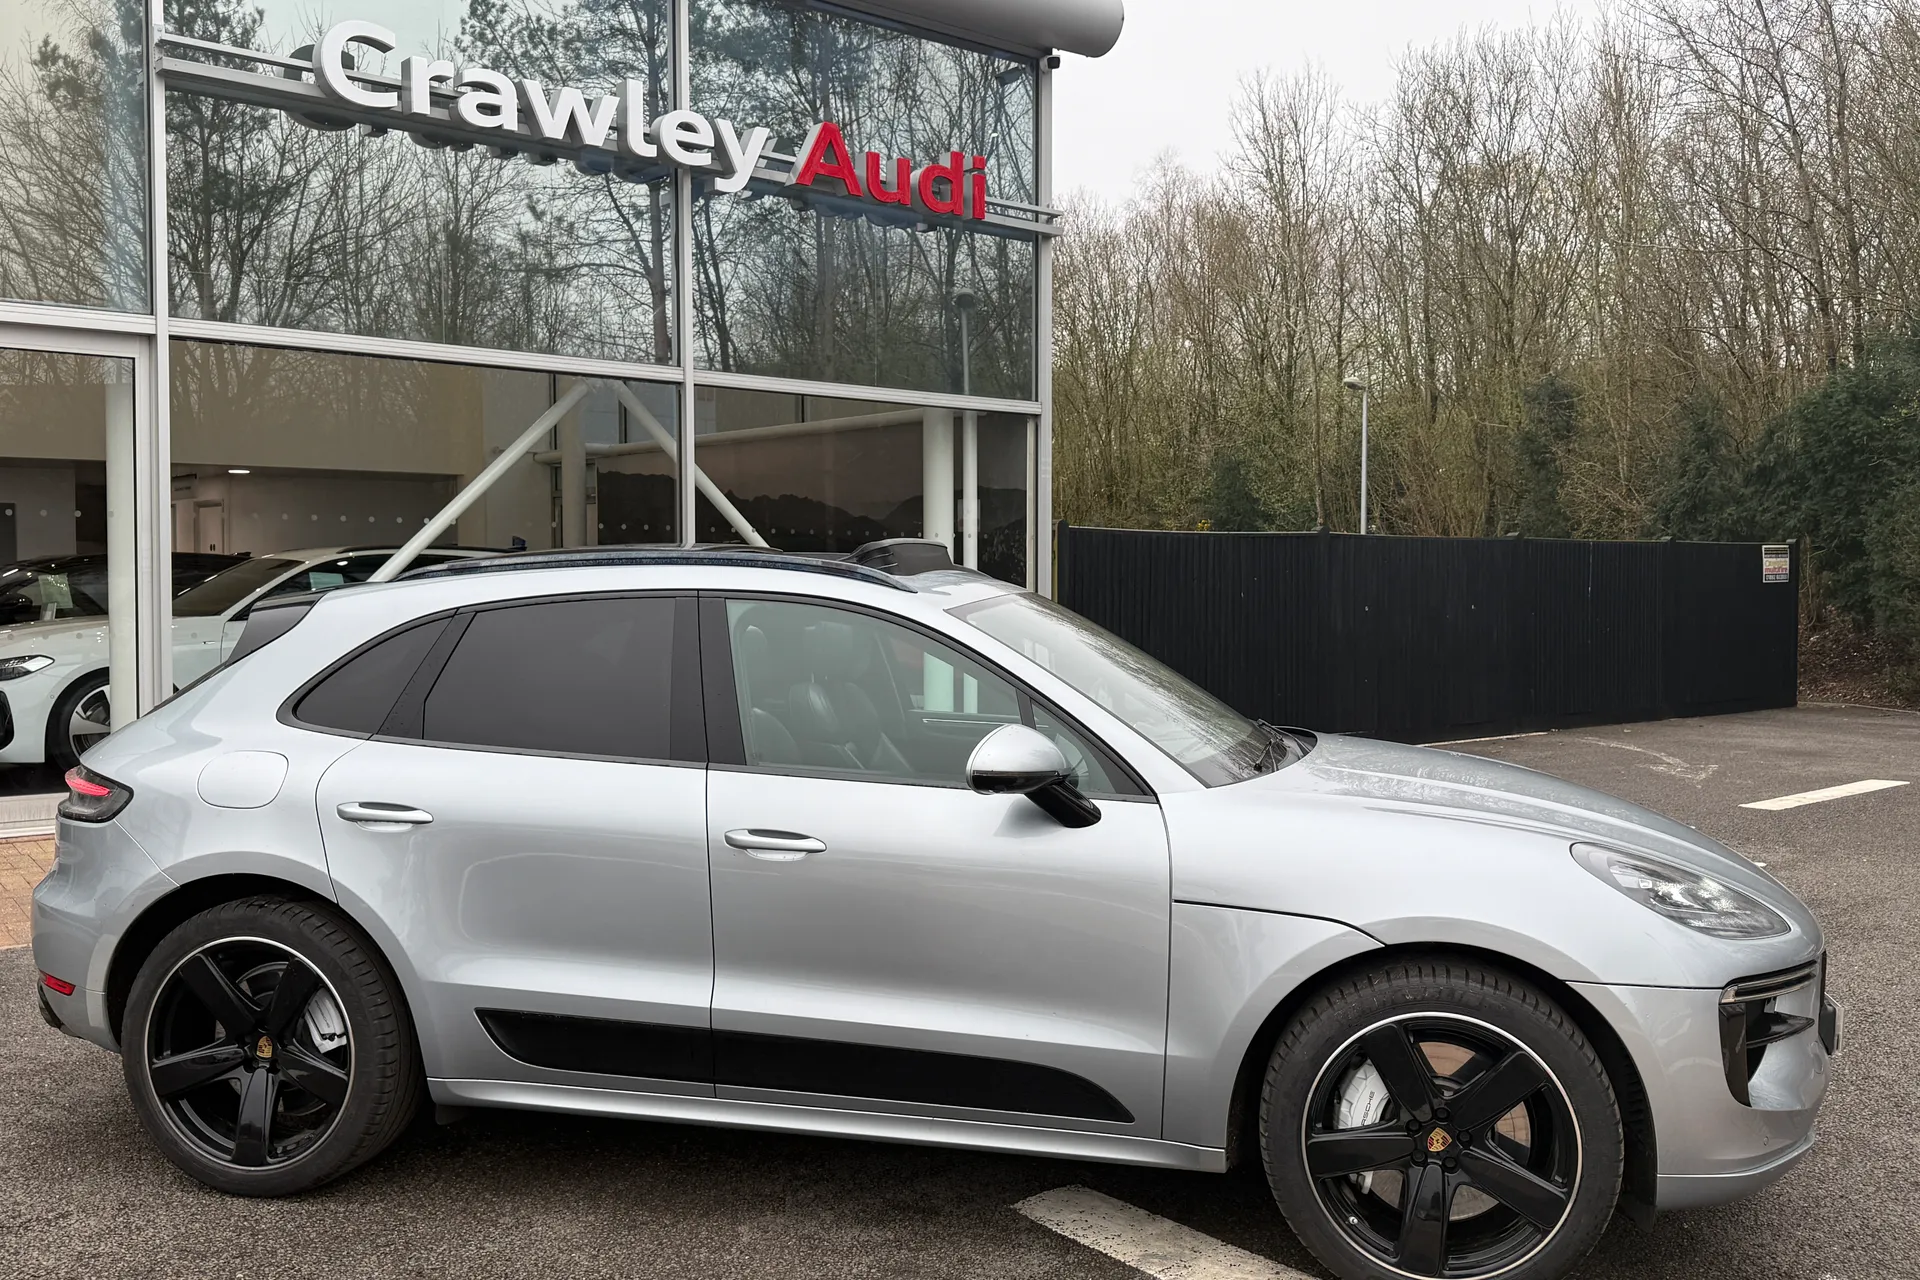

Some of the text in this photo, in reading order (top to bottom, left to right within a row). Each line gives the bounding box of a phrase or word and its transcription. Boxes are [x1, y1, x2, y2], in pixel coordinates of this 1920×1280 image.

[313, 20, 985, 219] Crawley Audi
[1360, 1090, 1376, 1126] RSCHE
